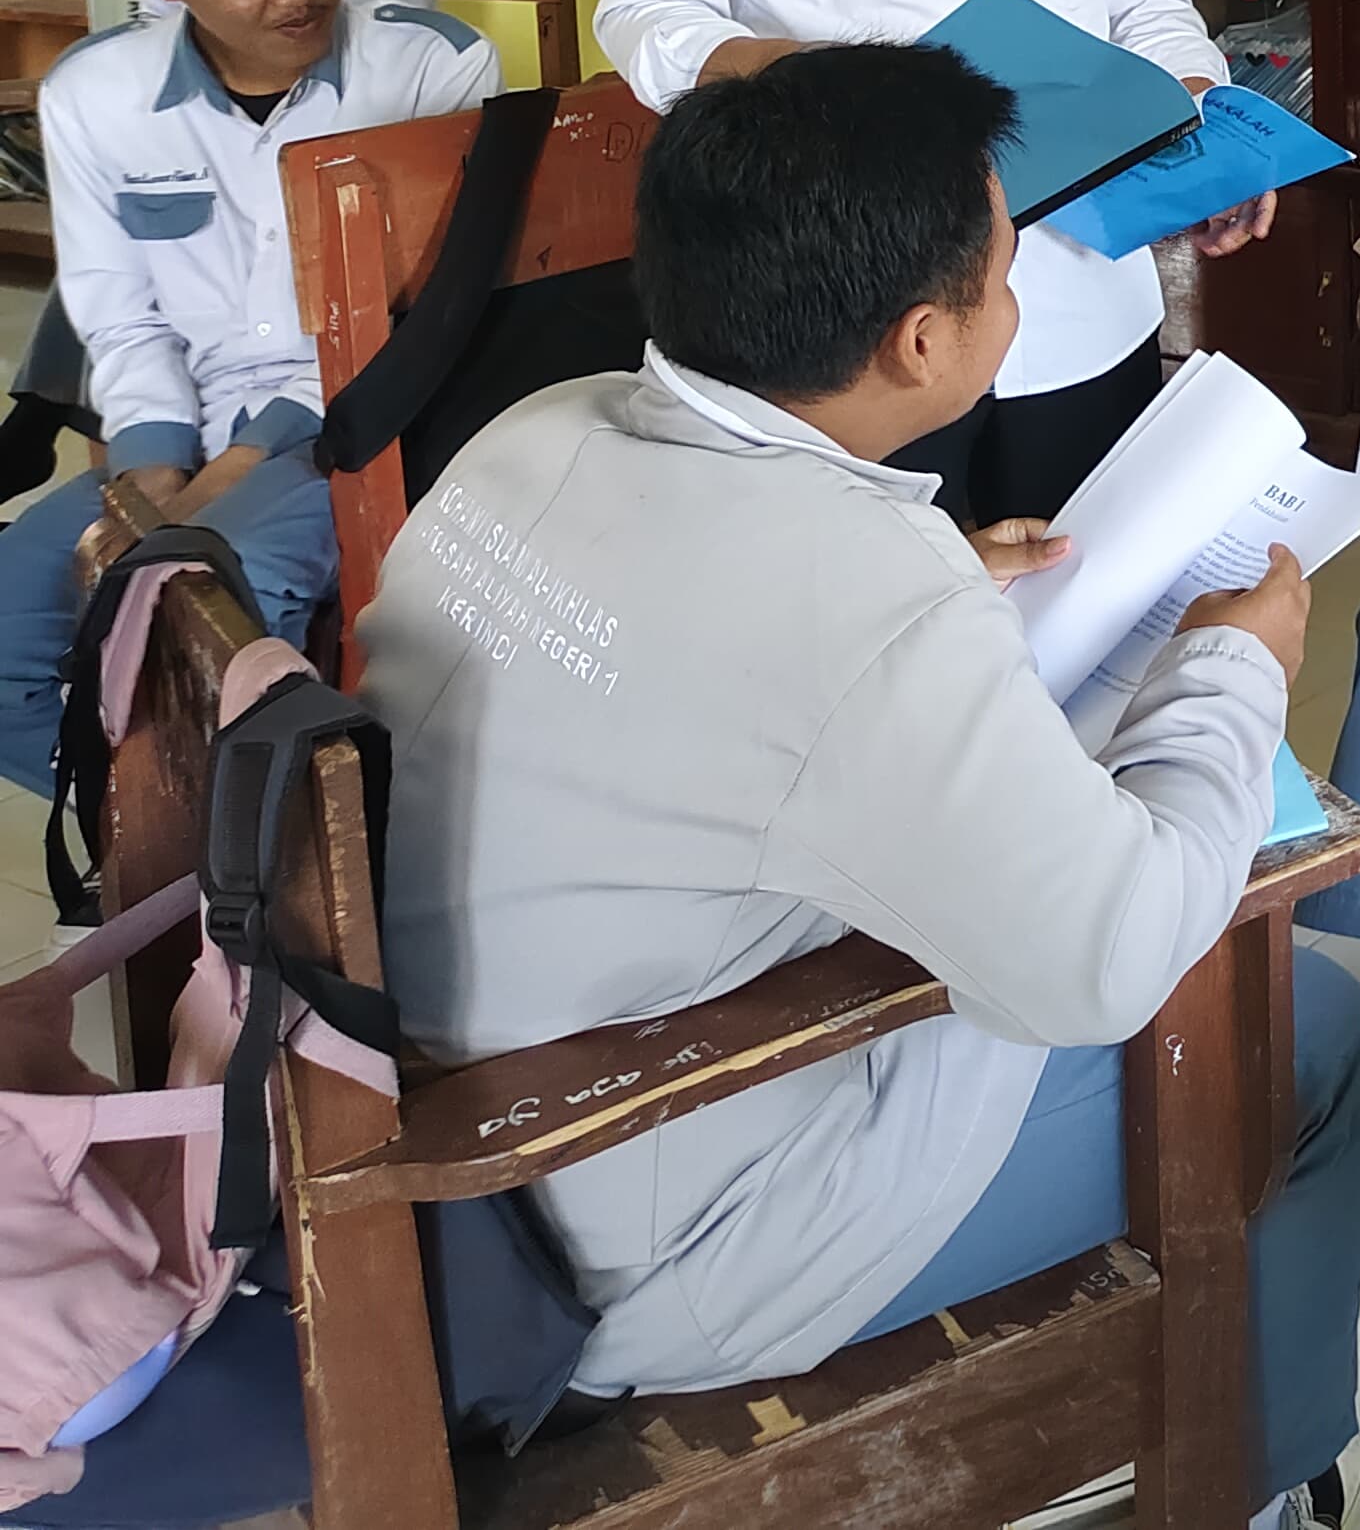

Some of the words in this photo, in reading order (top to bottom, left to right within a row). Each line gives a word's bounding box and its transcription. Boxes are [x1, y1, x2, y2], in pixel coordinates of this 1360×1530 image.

[1264, 483, 1298, 511] BAB
[436, 585, 518, 669] KERINCI
[526, 557, 618, 647] AL-IKHLAS
[528, 615, 600, 684] NEGERI
